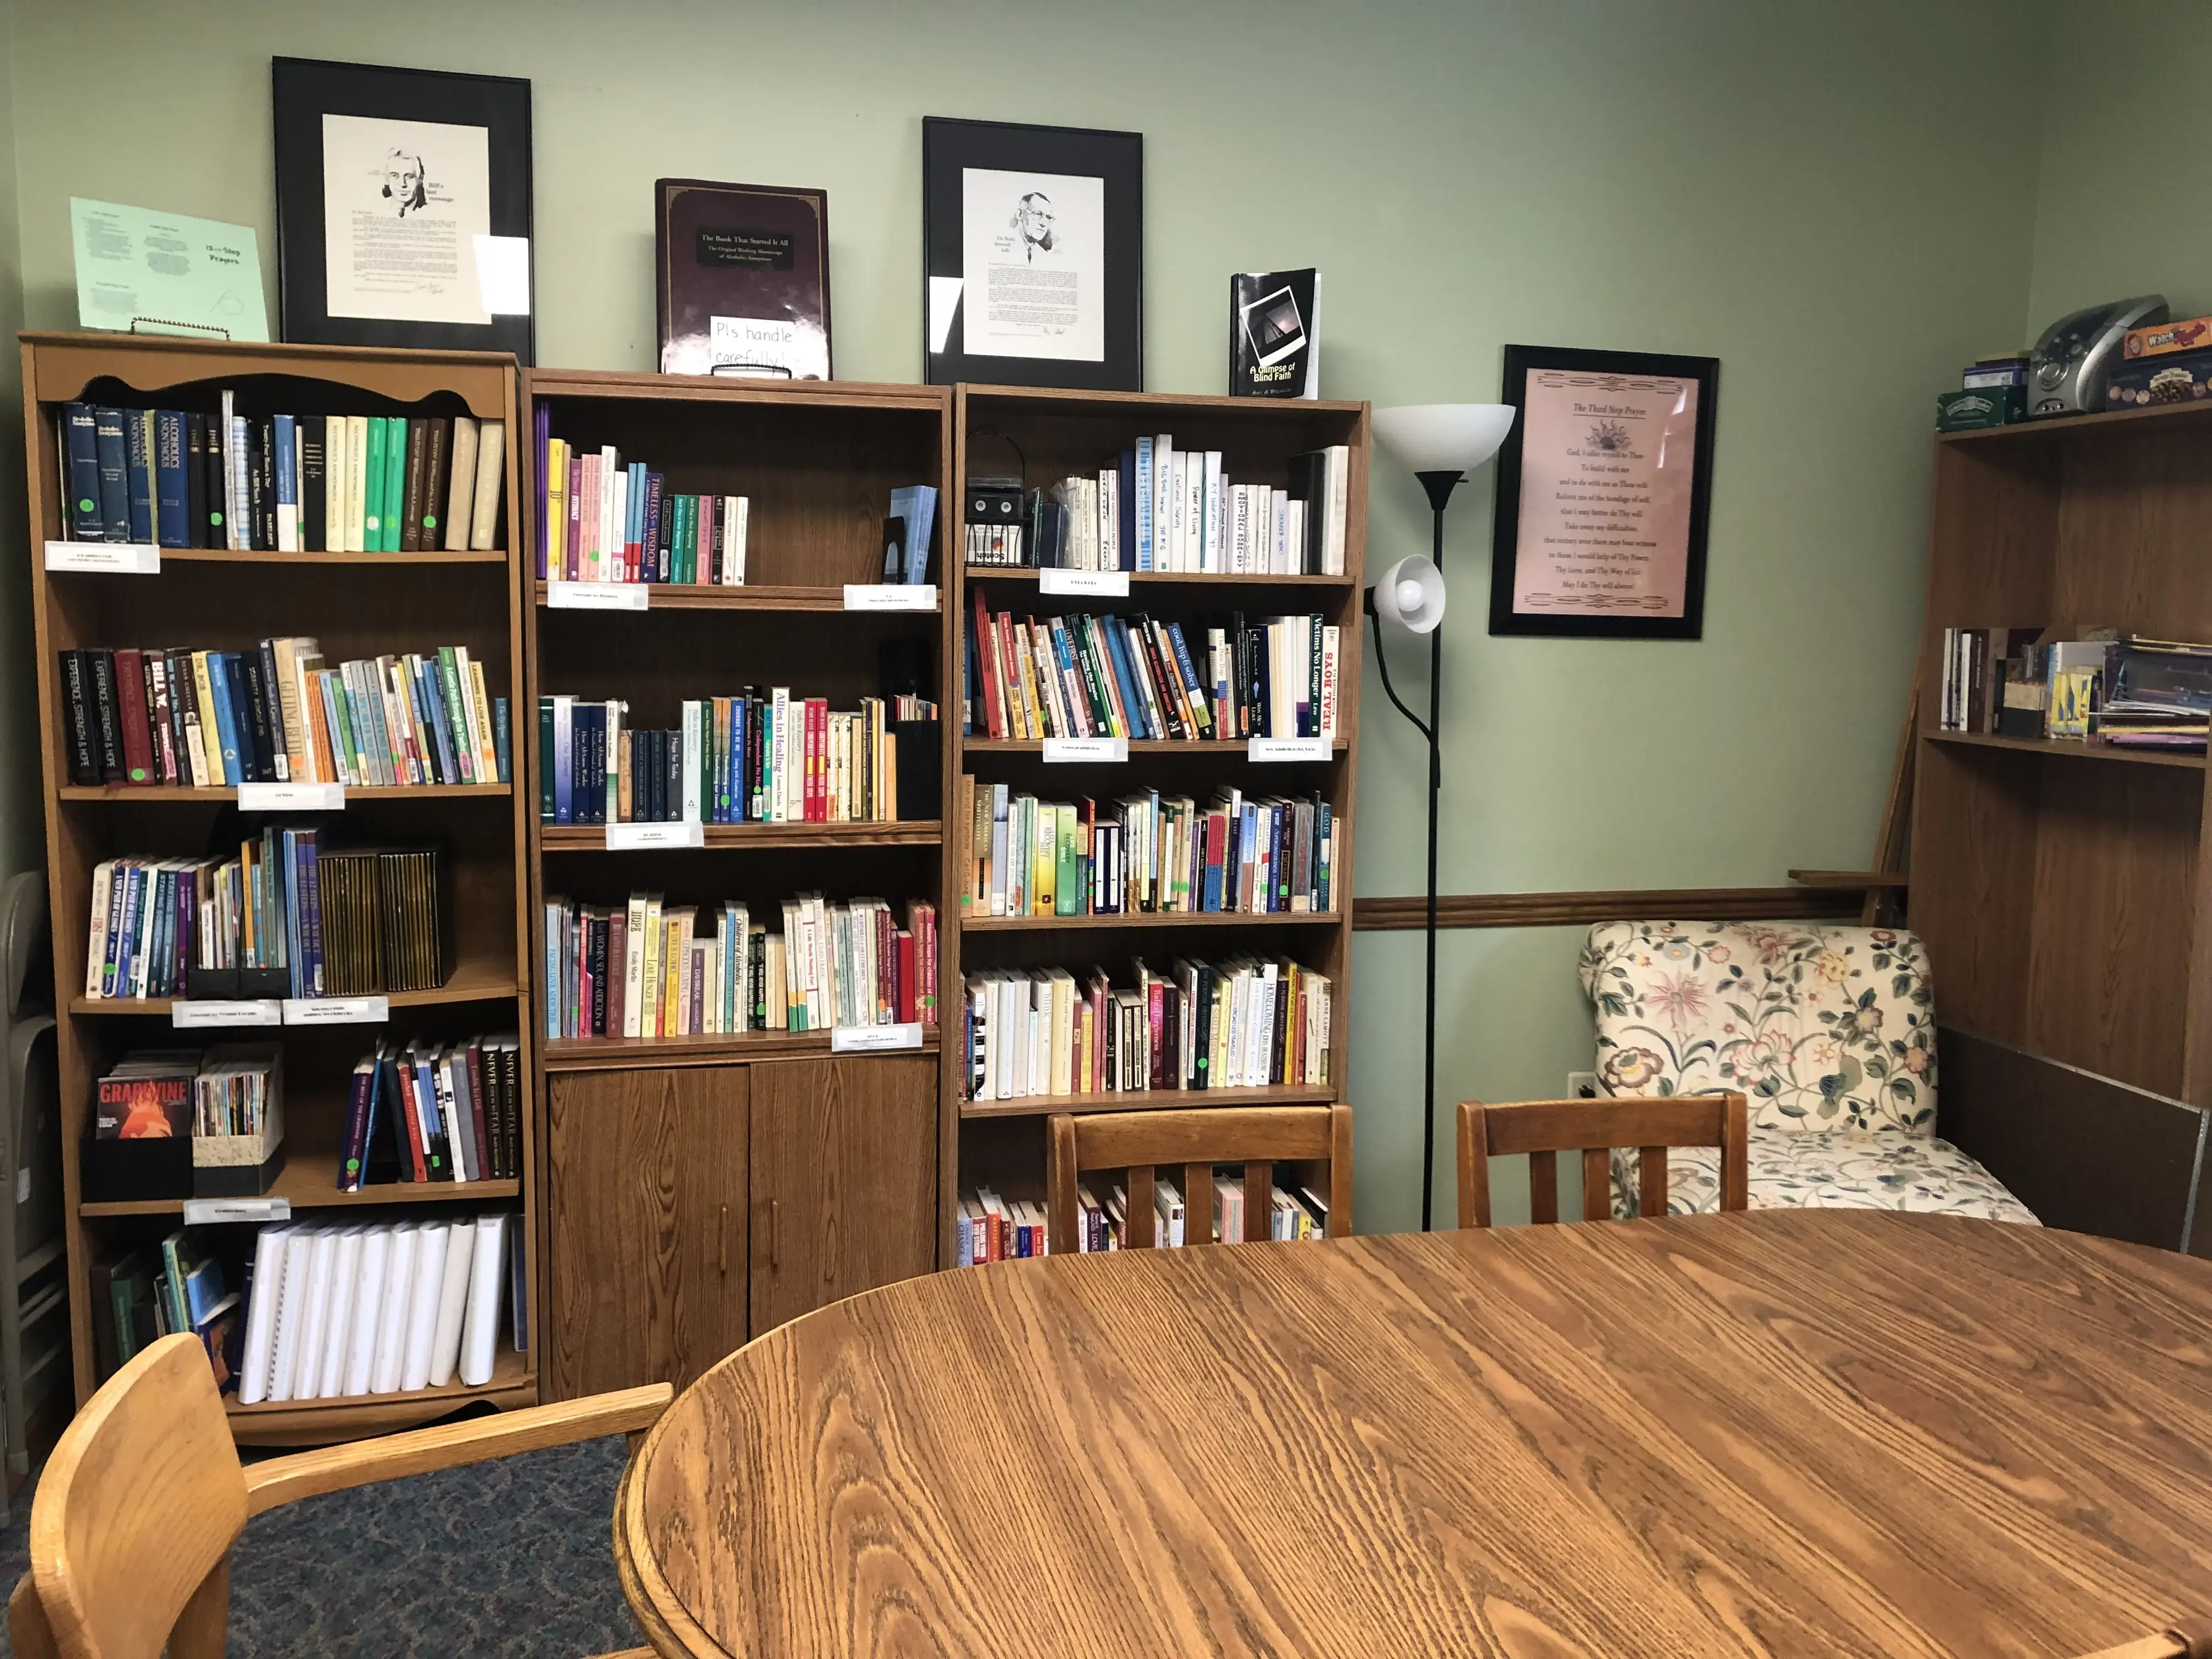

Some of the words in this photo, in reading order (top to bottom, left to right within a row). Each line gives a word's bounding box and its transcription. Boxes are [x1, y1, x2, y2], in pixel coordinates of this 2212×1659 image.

[716, 235, 731, 243] Book
[751, 237, 771, 245] Started
[208, 254, 240, 266] Prayers
[717, 322, 738, 338] Pls
[747, 325, 792, 342] handle
[1250, 366, 1256, 374] A
[1258, 365, 1286, 374] Glimpse
[1288, 362, 1295, 370] of
[1254, 373, 1272, 382] Blind
[1274, 371, 1291, 380] Faith
[1574, 404, 1585, 412] The
[1588, 404, 1607, 414] Third
[1609, 406, 1623, 416] Step
[1624, 408, 1646, 416] Prayer
[160, 415, 170, 467] ANONYMOUS
[170, 416, 179, 468] ALCOHOLICS
[650, 477, 659, 519] TIMELESS
[1190, 518, 1198, 534] Living
[647, 528, 656, 567] WISDOM
[977, 552, 1005, 561] Scotch
[195, 658, 204, 672] DR.
[1172, 628, 1183, 647] cool,
[1178, 647, 1187, 659] hip
[1184, 667, 1195, 687] sober
[1314, 652, 1321, 663] No
[151, 661, 165, 691] BILL
[472, 665, 481, 695] LEARNING
[1082, 650, 1090, 670] Healing
[1090, 683, 1098, 701] Healer
[1324, 652, 1333, 688] BOYS
[198, 674, 206, 691] BOB
[156, 692, 167, 708] W.
[446, 671, 454, 688] Gentle
[452, 702, 461, 723] through
[776, 692, 785, 720] Allies
[1323, 692, 1331, 730] REAL
[100, 705, 112, 741] STRENGTH
[777, 723, 784, 732] in
[105, 749, 115, 768] HOPE
[772, 735, 785, 772] Healing
[630, 910, 642, 932] HOPE
[596, 935, 605, 960] WOMEN
[646, 960, 657, 974] LOVE
[596, 974, 604, 986] AND
[645, 977, 656, 998] HUNGER
[595, 988, 604, 1018] ADDICTION
[1263, 983, 1275, 1034] HOMECOMING
[505, 1054, 514, 1085] NEVER
[100, 1081, 187, 1103] GRAPEVINE
[507, 1113, 516, 1135] FEAR
